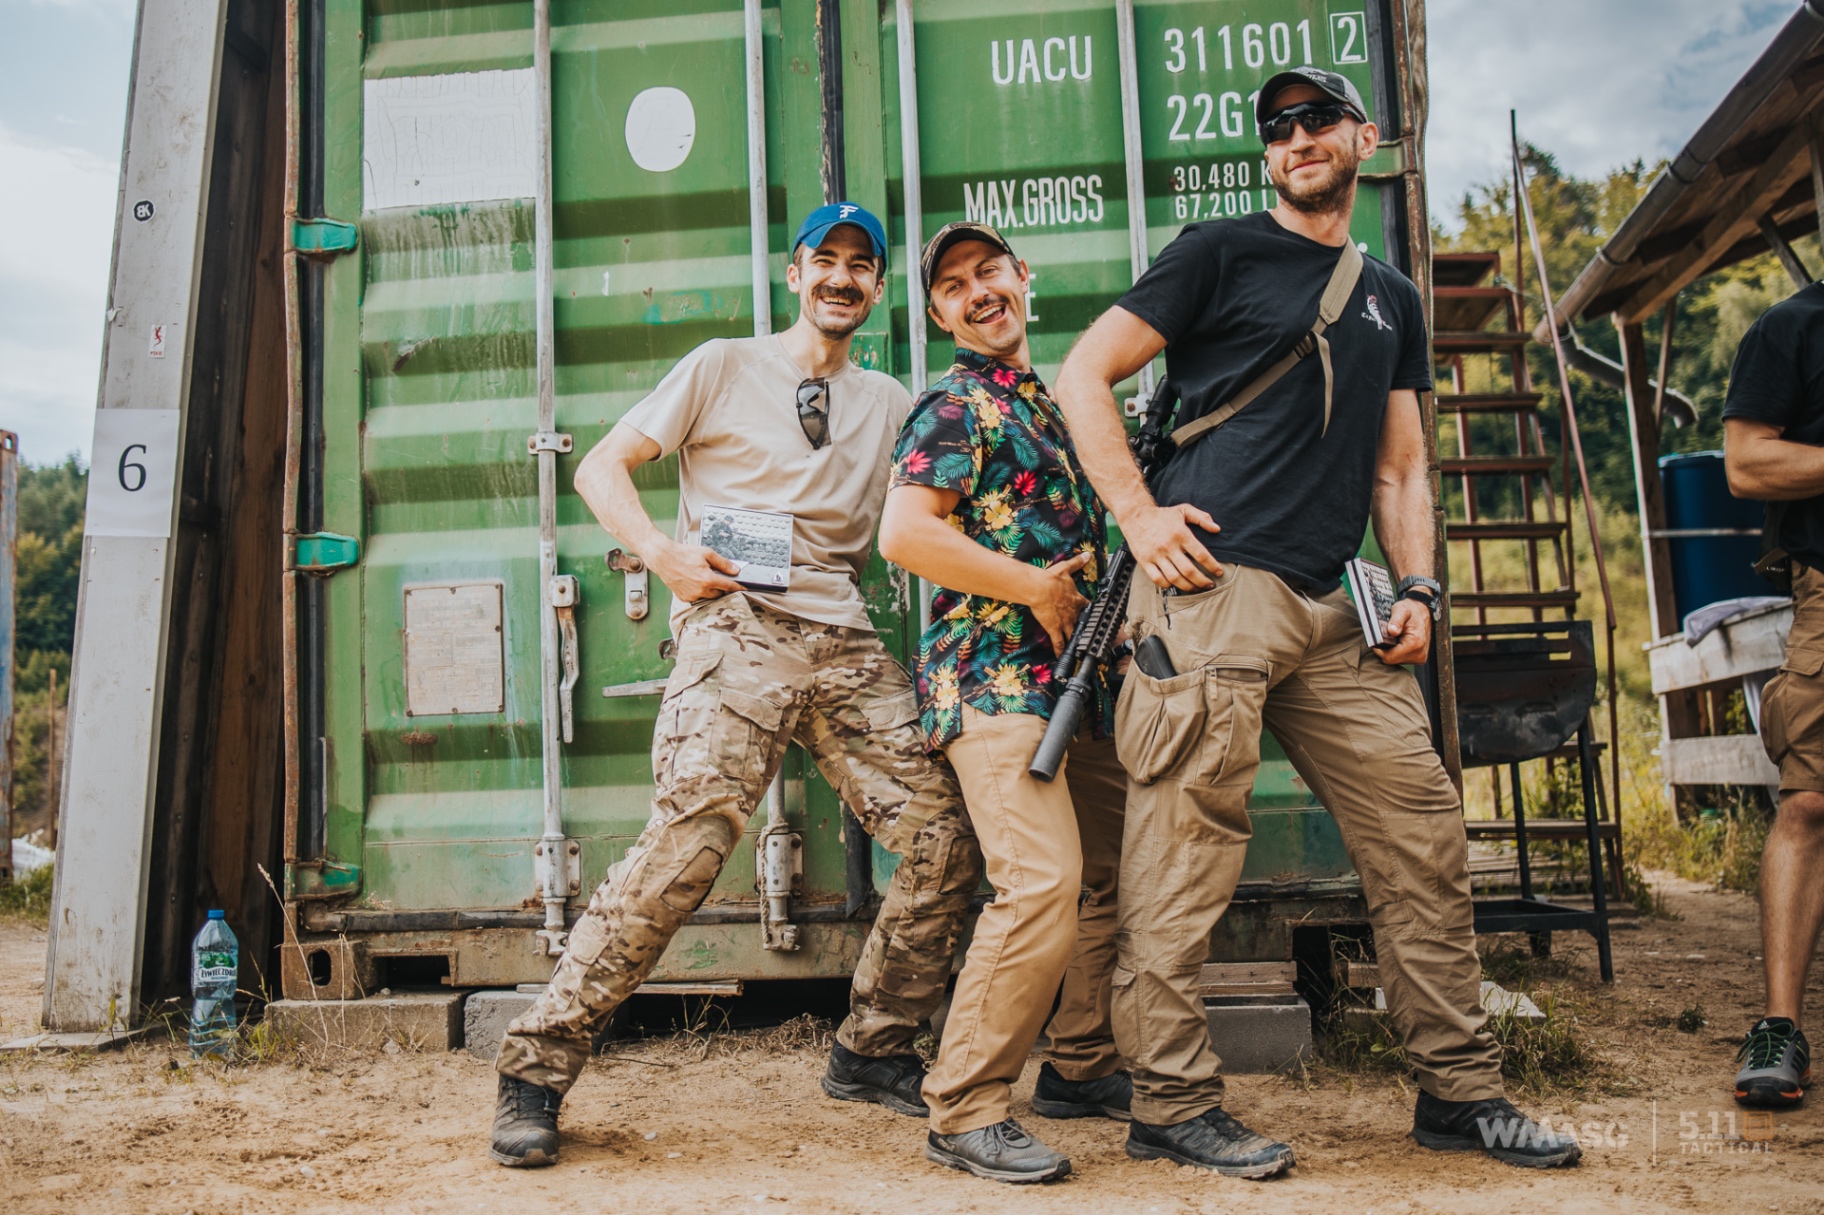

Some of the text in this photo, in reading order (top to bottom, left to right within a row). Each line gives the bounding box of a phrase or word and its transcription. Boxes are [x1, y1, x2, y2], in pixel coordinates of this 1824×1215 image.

[991, 15, 1363, 85] UACU 311601 2
[963, 160, 1274, 229] MAX.GROSS 30,480 K
[1175, 189, 1280, 219] 67,200 L
[117, 443, 147, 492] 6
